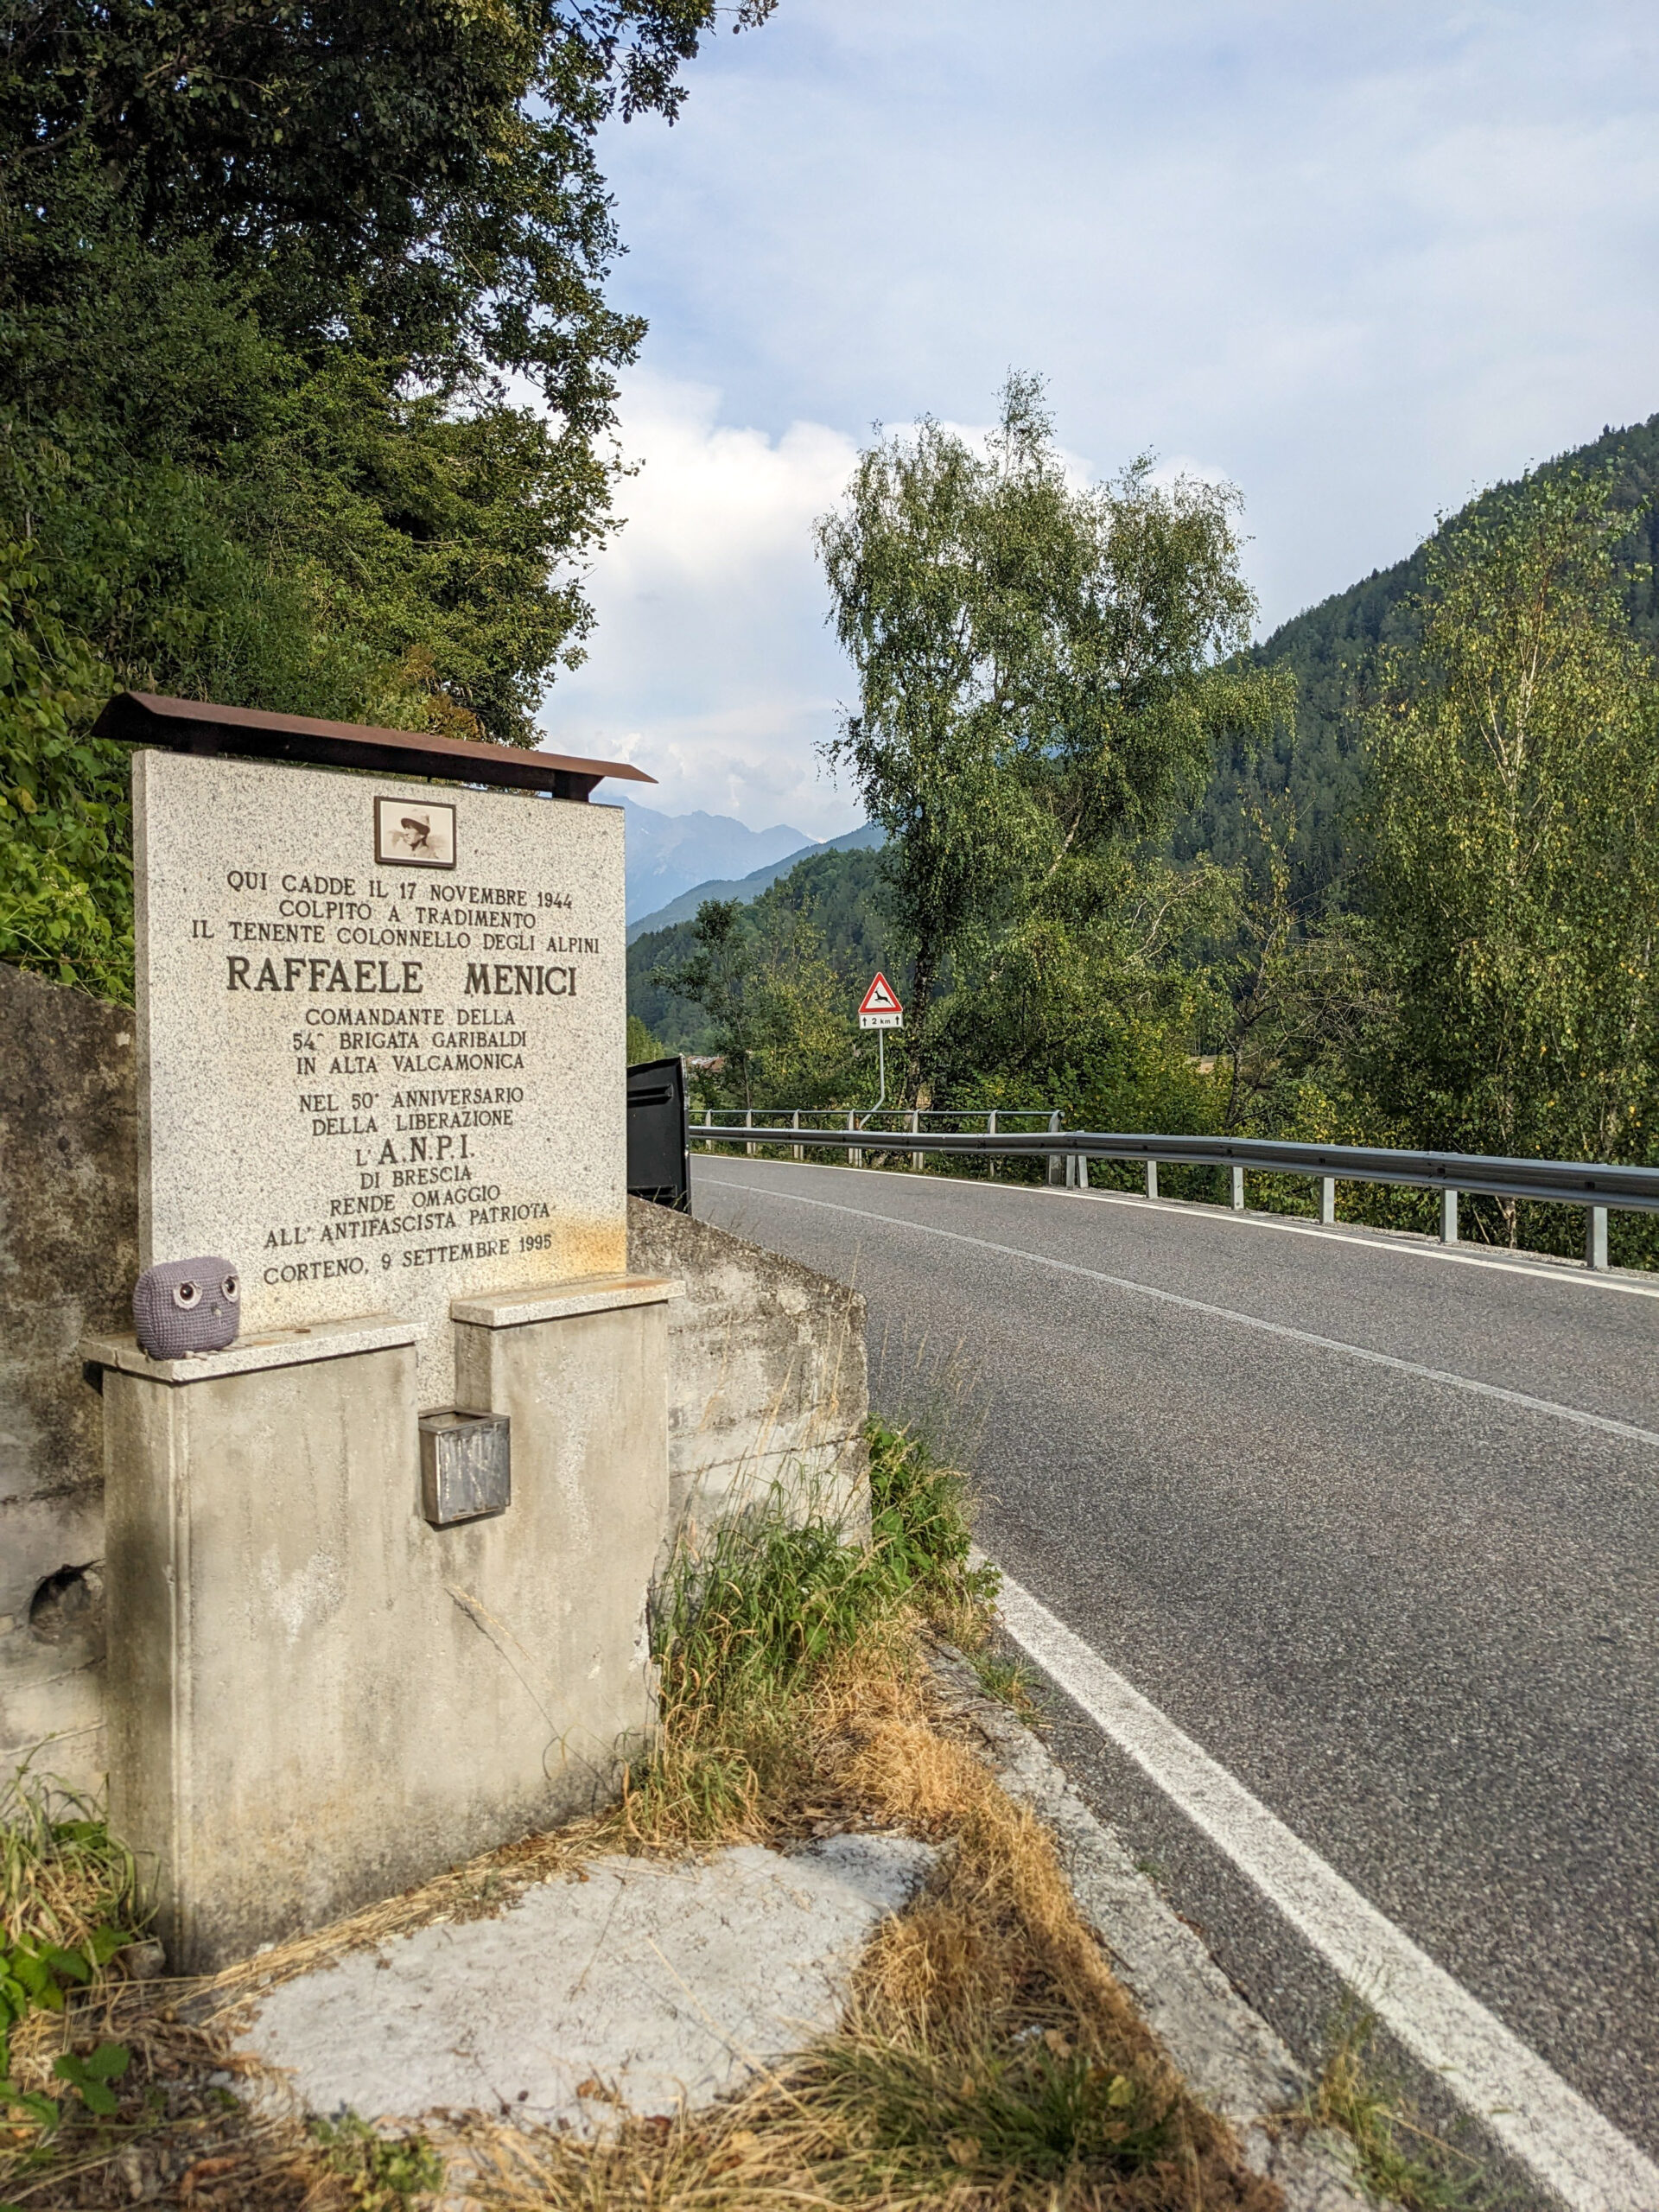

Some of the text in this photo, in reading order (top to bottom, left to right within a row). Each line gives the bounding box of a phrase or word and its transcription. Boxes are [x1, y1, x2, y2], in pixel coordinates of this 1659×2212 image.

[227, 871, 573, 908] QUI CADDE IL 17 NOVEMBRE 1944
[279, 900, 536, 928] COLPITO A TRADIMENTO
[192, 920, 600, 954] IL TENENTE COLONNELLO DEGLI ALPINI
[226, 956, 577, 996] RAFFAELE MENICI
[306, 1009, 515, 1026] COMANDANTE DELLA
[340, 1032, 419, 1049] BRIGATA
[432, 1031, 527, 1047] GARIBALDI
[297, 1053, 524, 1074] IN ALTA VALCAMONICA
[299, 1094, 340, 1112] NEL
[391, 1087, 524, 1109] ANNIVERSARIO
[312, 1110, 513, 1136] DELLA LIBERAZIONE
[360, 1166, 472, 1190] DI BRESCIA
[329, 1185, 501, 1217] RENDE OMAGGIO
[321, 1214, 456, 1242] ANTIFASCISTA
[469, 1204, 550, 1225] PATRIOTA
[264, 1235, 552, 1286] CORTENO, 9 SETTEMBRE 1995
